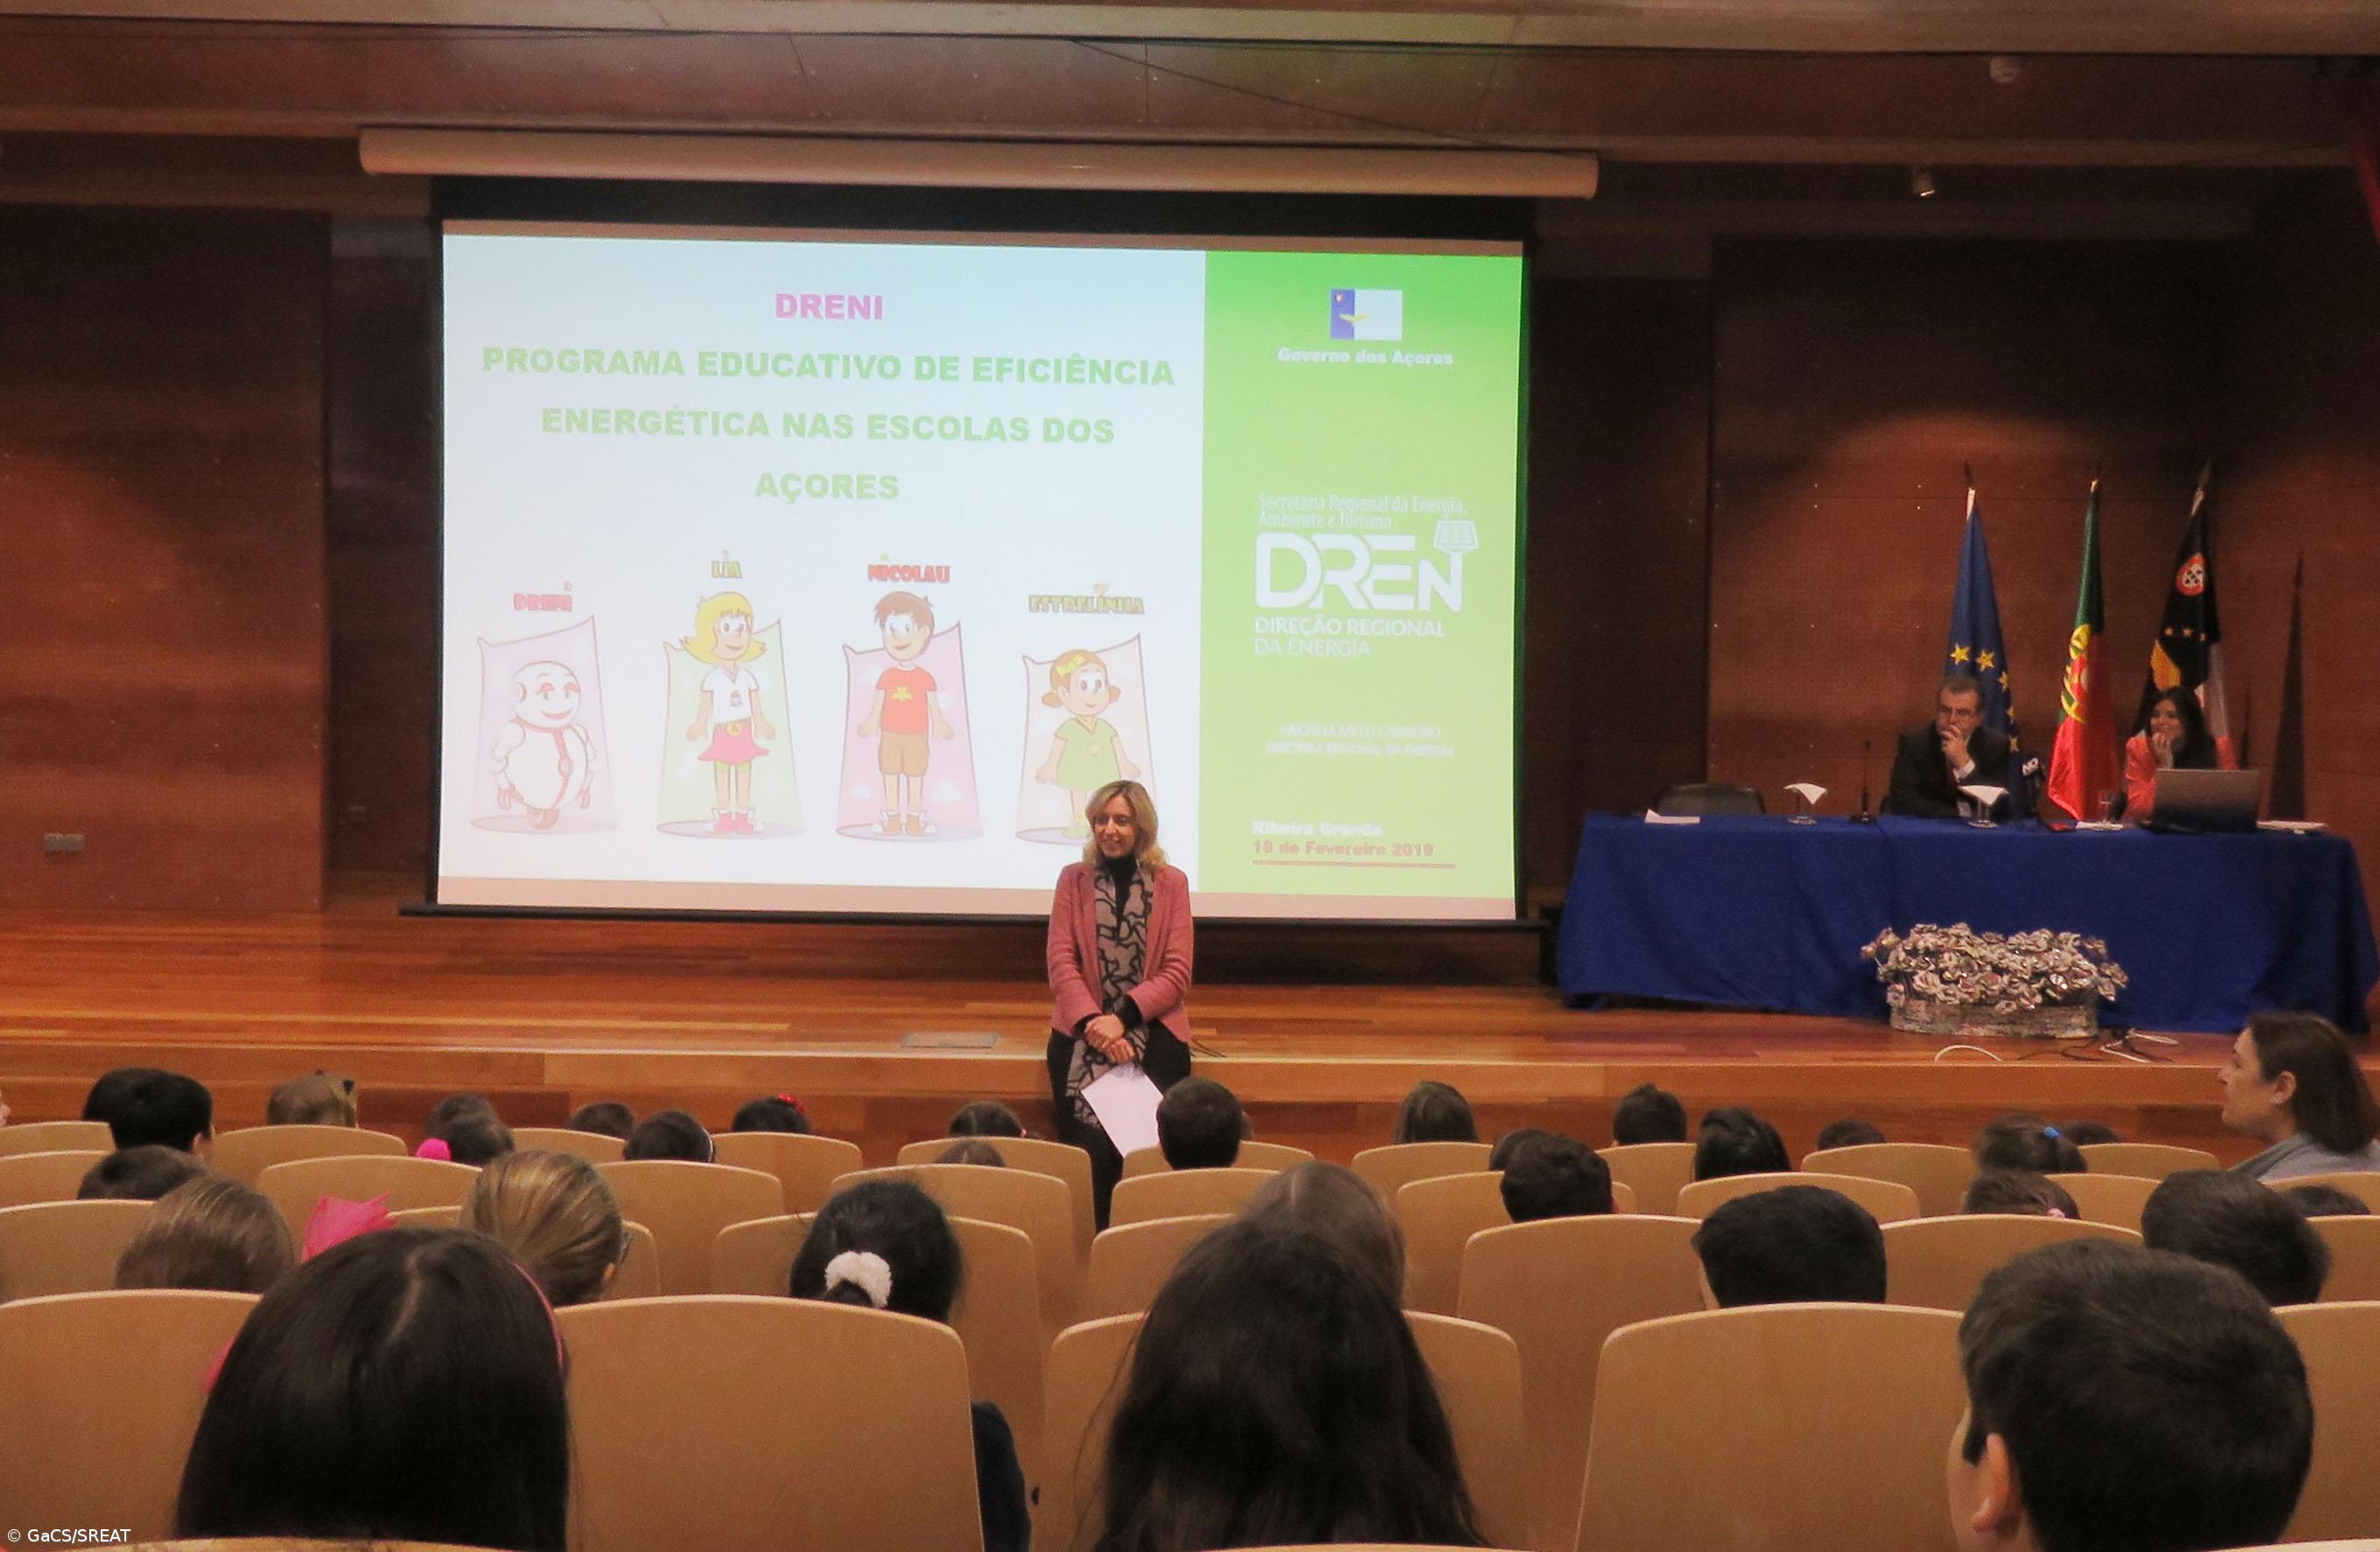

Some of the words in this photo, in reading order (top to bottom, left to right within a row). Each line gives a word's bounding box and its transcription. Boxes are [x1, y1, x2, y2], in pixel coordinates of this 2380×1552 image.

[775, 293, 884, 320] DRENI
[484, 347, 685, 377] PROGRAMA
[700, 350, 901, 381] EDUCATIVO
[915, 356, 960, 383] DE
[972, 353, 1175, 386] EFICIÊNCIA
[1277, 347, 1350, 363] Governo
[1356, 349, 1386, 363] dos
[1392, 349, 1453, 366] Açores
[541, 406, 770, 438] ENERGÉTICA
[783, 413, 854, 440] NAS
[867, 414, 1029, 443] ESCOLAS
[1042, 418, 1114, 444] DOS
[754, 472, 900, 504] AÇORES
[1255, 532, 1463, 612] DREN
[1254, 614, 1342, 637] DIREÇÃO
[1347, 618, 1445, 638] REGIONAL
[1254, 638, 1282, 655] DA
[1288, 639, 1372, 657] ENERGIA
[1279, 841, 1299, 854] de
[1305, 841, 1387, 856] Fevereiro
[1392, 843, 1434, 857] 2019
